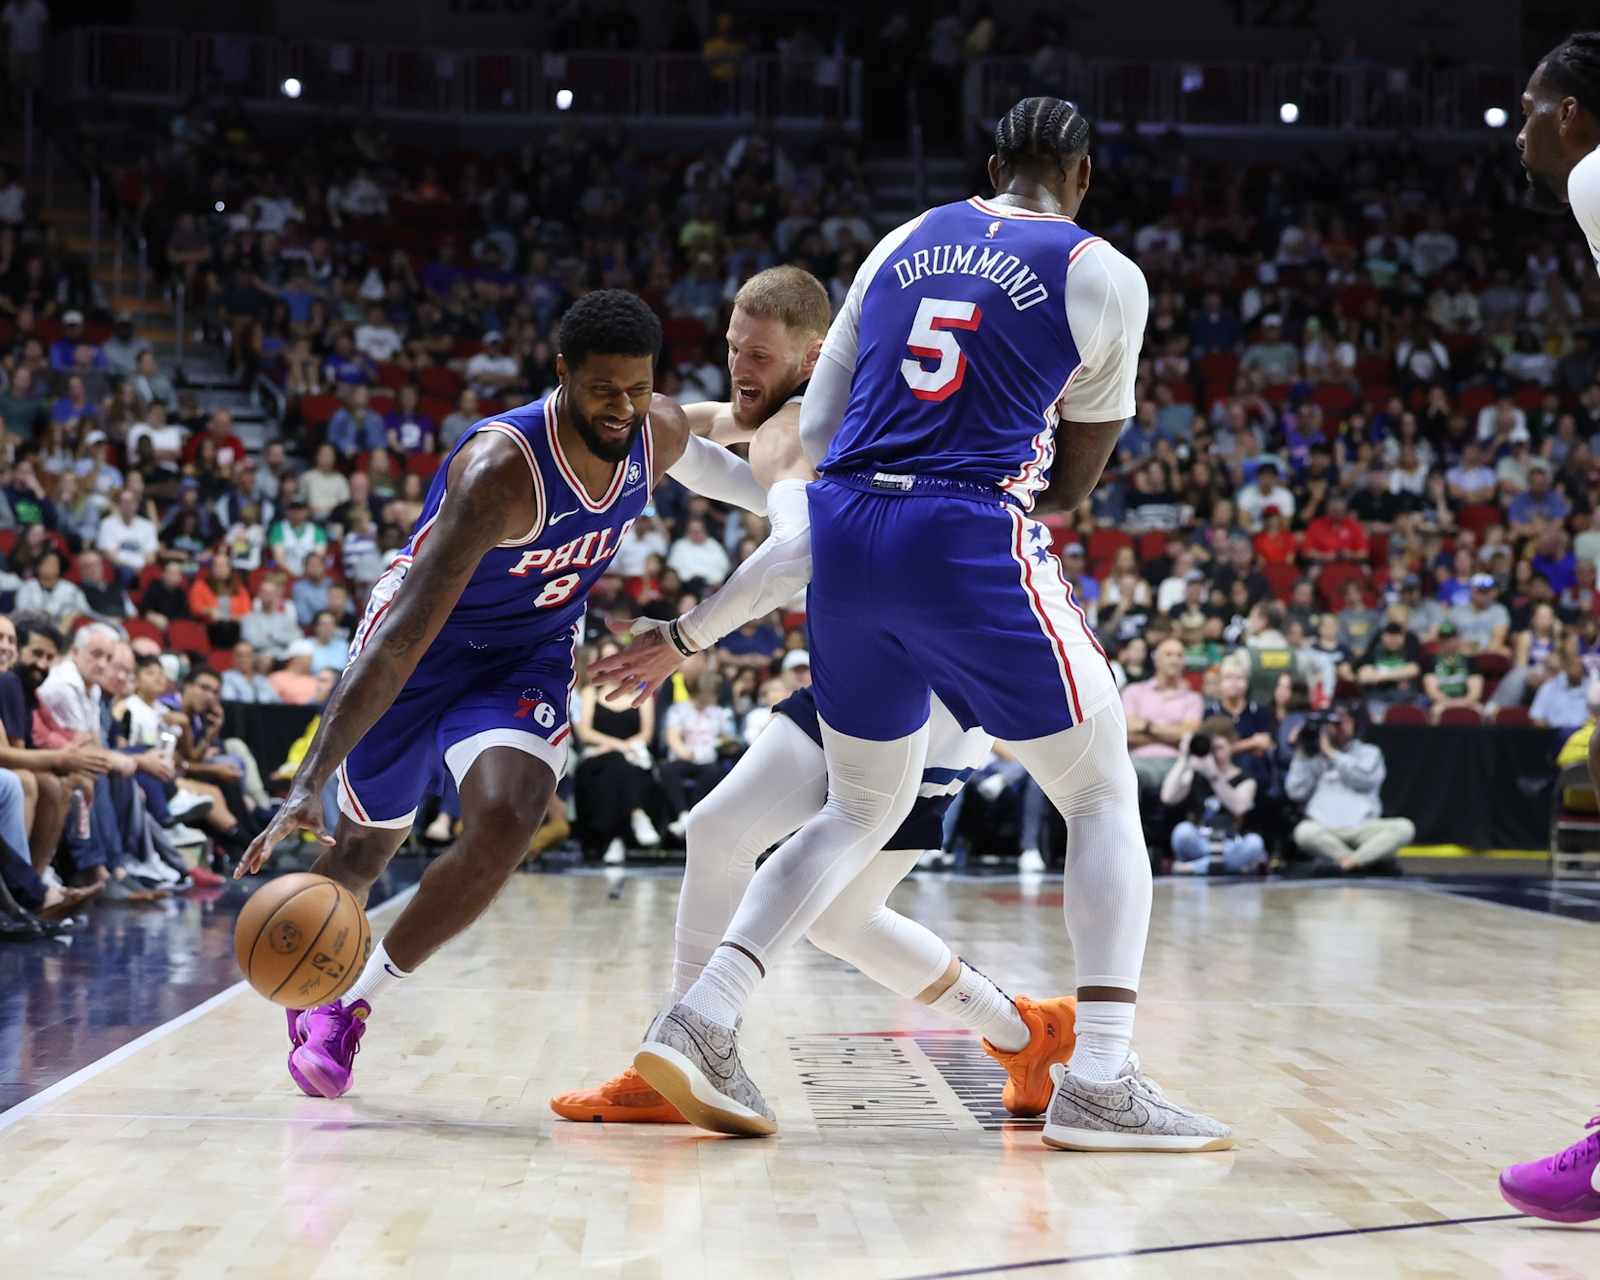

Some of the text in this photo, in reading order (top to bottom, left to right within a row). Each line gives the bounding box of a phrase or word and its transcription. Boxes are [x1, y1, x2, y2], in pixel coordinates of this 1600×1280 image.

[893, 244, 1049, 311] DRUMMOND
[900, 297, 983, 402] 5
[533, 572, 581, 608] 8
[513, 697, 556, 728] 76
[798, 1071, 959, 1131] COMPANY
